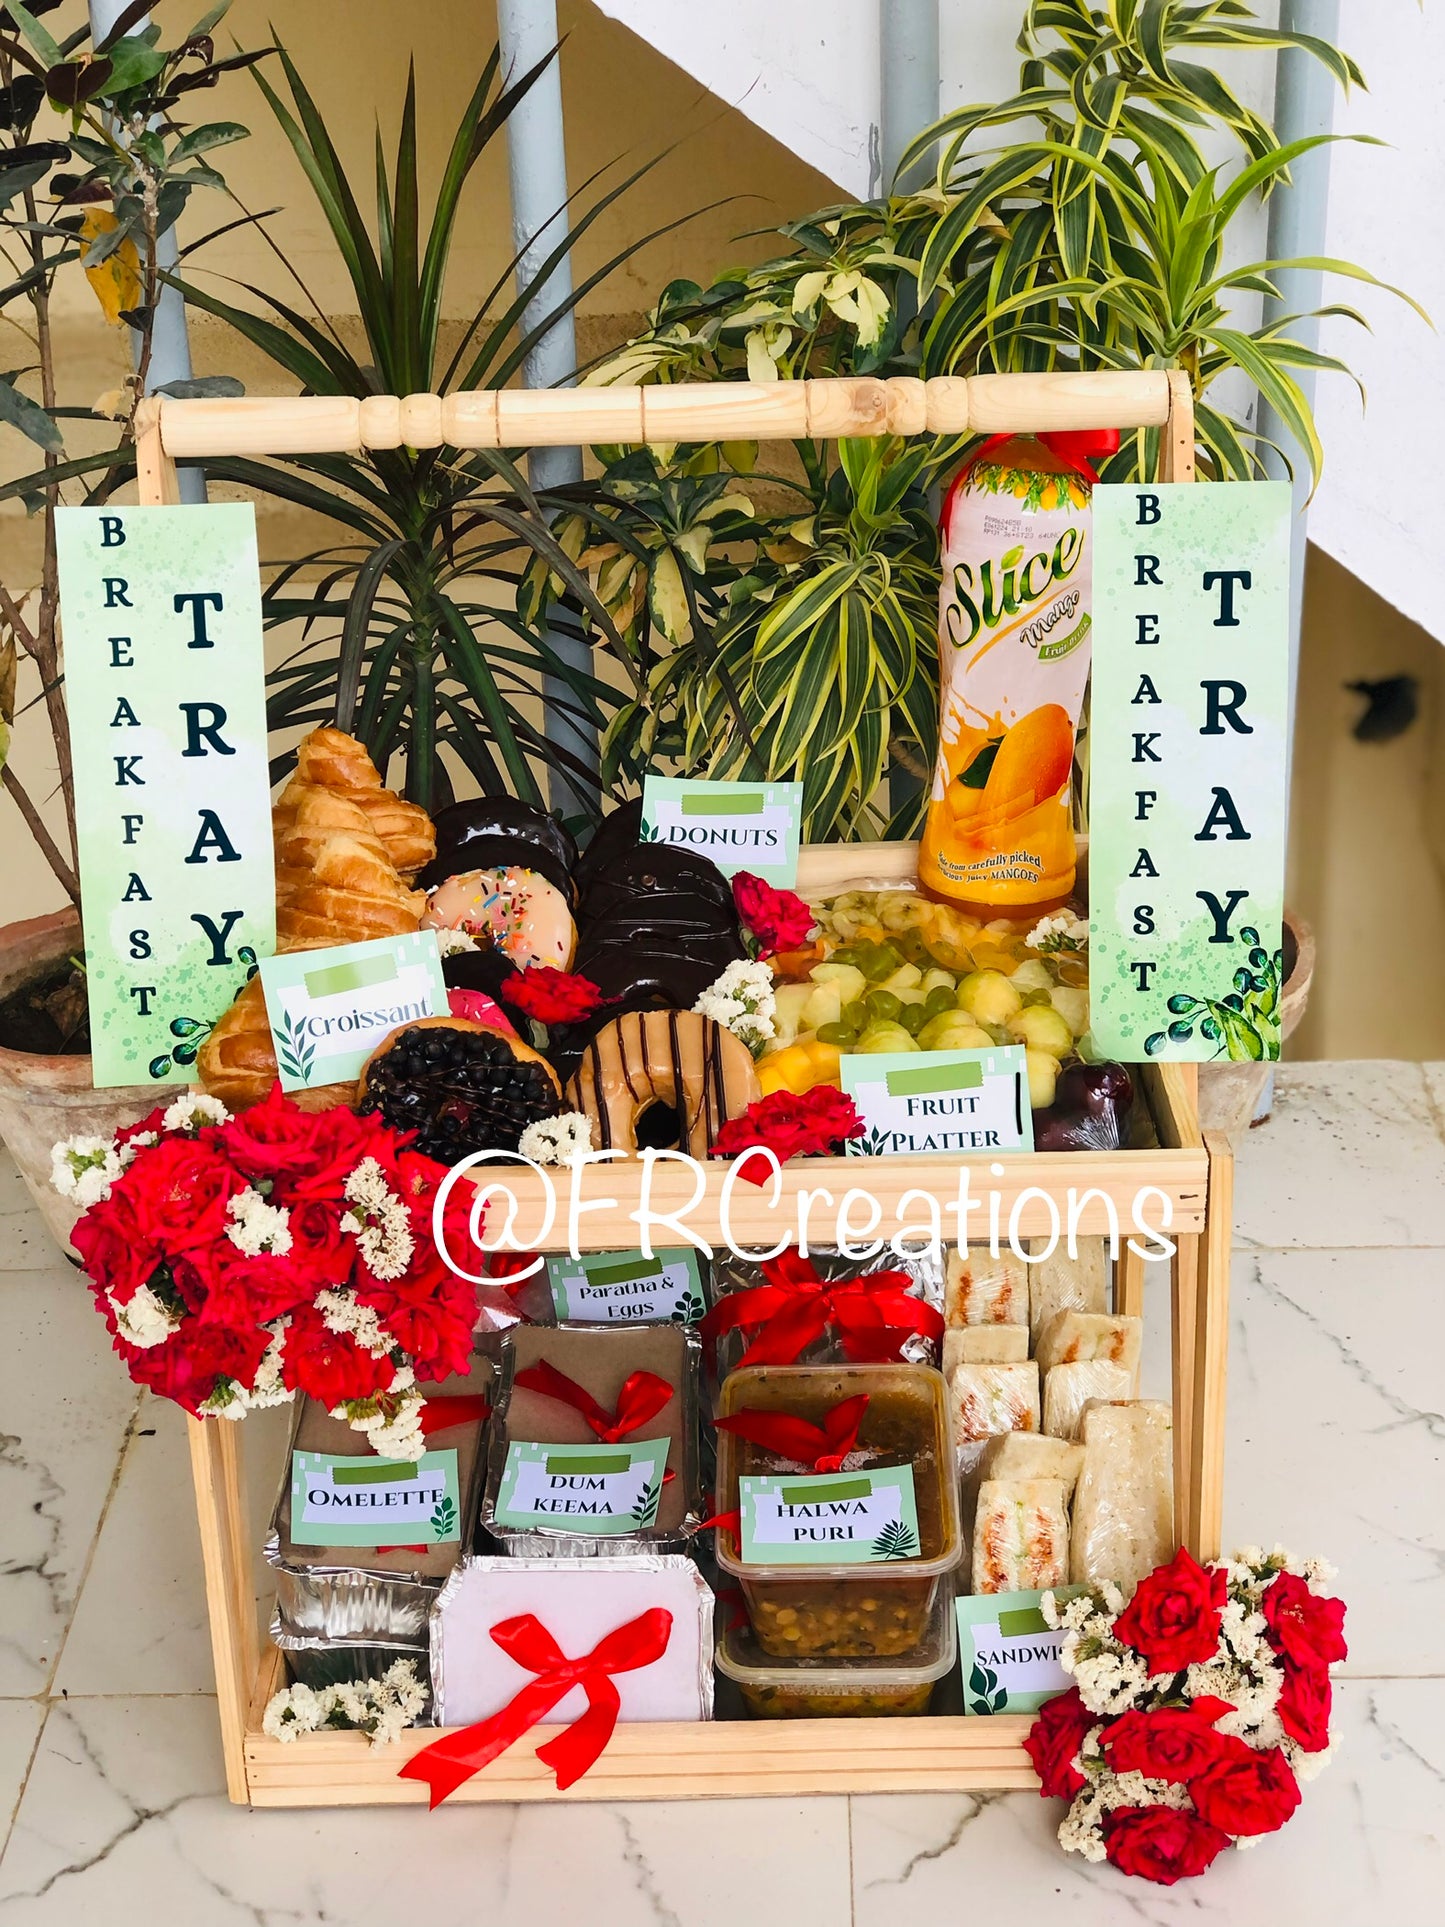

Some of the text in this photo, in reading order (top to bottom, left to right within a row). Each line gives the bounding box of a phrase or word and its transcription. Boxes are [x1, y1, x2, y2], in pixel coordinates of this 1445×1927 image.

[945, 526, 1086, 650] Slice
[1019, 589, 1081, 649] Mango
[1129, 493, 1164, 992] BREAKFAST
[99, 516, 156, 1016] BREAKFAST
[1194, 570, 1254, 944] TRAY
[173, 592, 244, 966] TRAY
[669, 825, 778, 847] DONUTS
[948, 861, 966, 871] from
[967, 853, 1008, 871] carefully
[990, 867, 1040, 884] MANGOES
[307, 997, 434, 1038] Croissant
[906, 1096, 980, 1117] FRUIT
[891, 1129, 1001, 1152] PLATTER
[579, 1275, 675, 1300] Paratha &
[608, 1302, 654, 1320] Eggs
[549, 1475, 606, 1491] DUM
[307, 1487, 444, 1509] OMELETTE
[533, 1498, 614, 1515] KEEMA
[777, 1501, 869, 1519] HALWA
[793, 1525, 855, 1542] PURI
